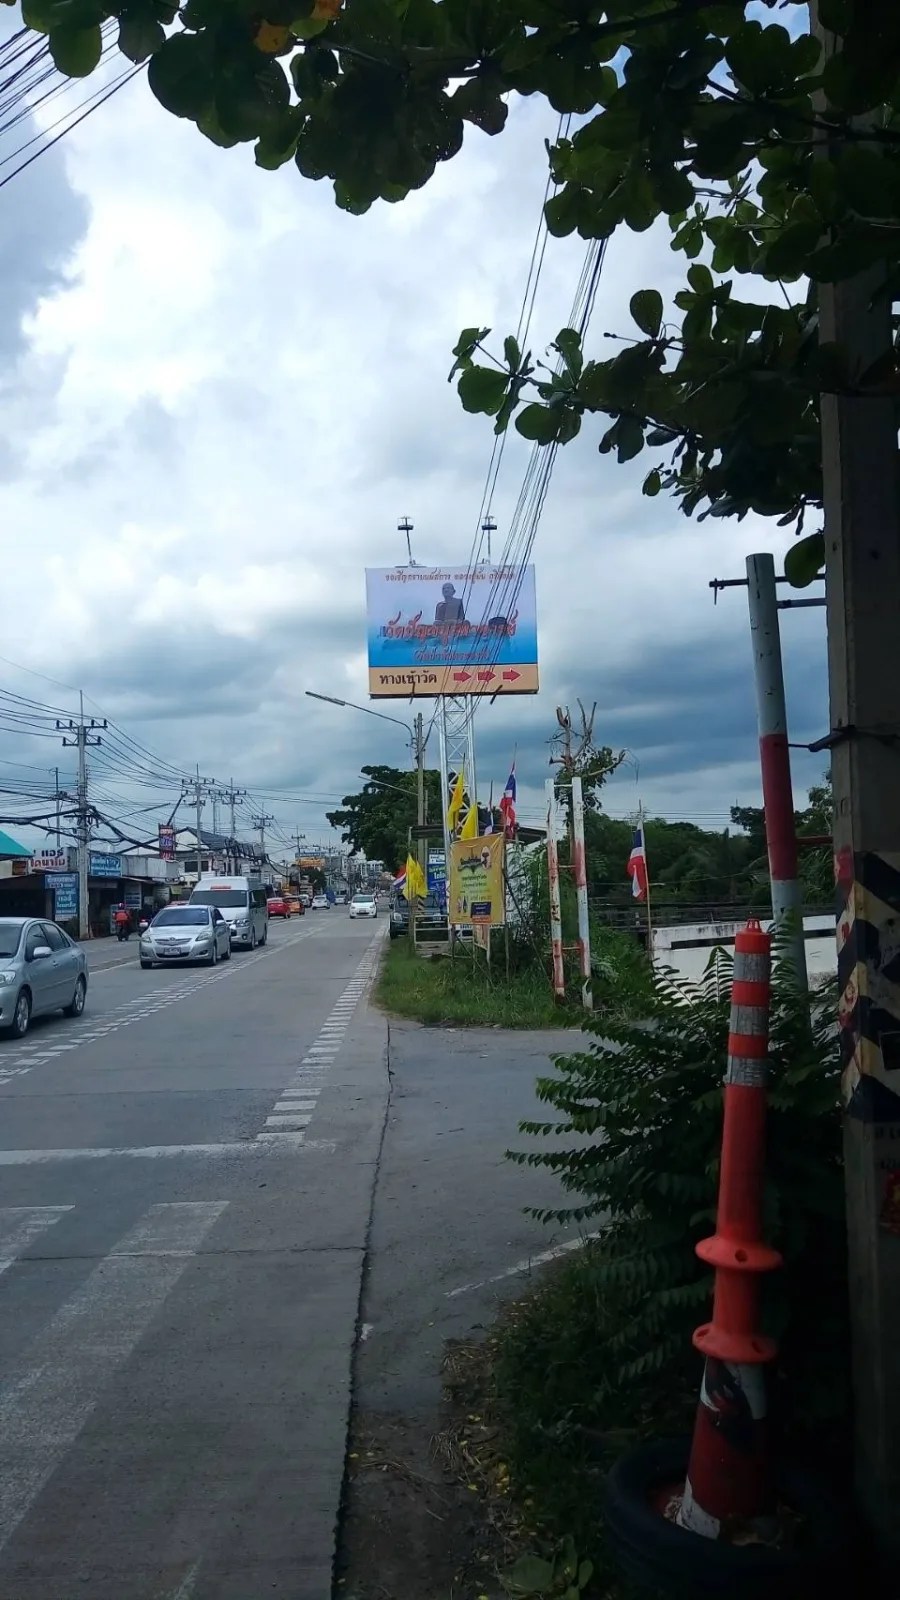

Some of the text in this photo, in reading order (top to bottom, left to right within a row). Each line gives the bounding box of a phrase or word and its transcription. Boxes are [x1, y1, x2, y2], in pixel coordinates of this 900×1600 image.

[379, 670, 437, 685] ทางเข้าวัด
[41, 847, 64, 859] แอร์
